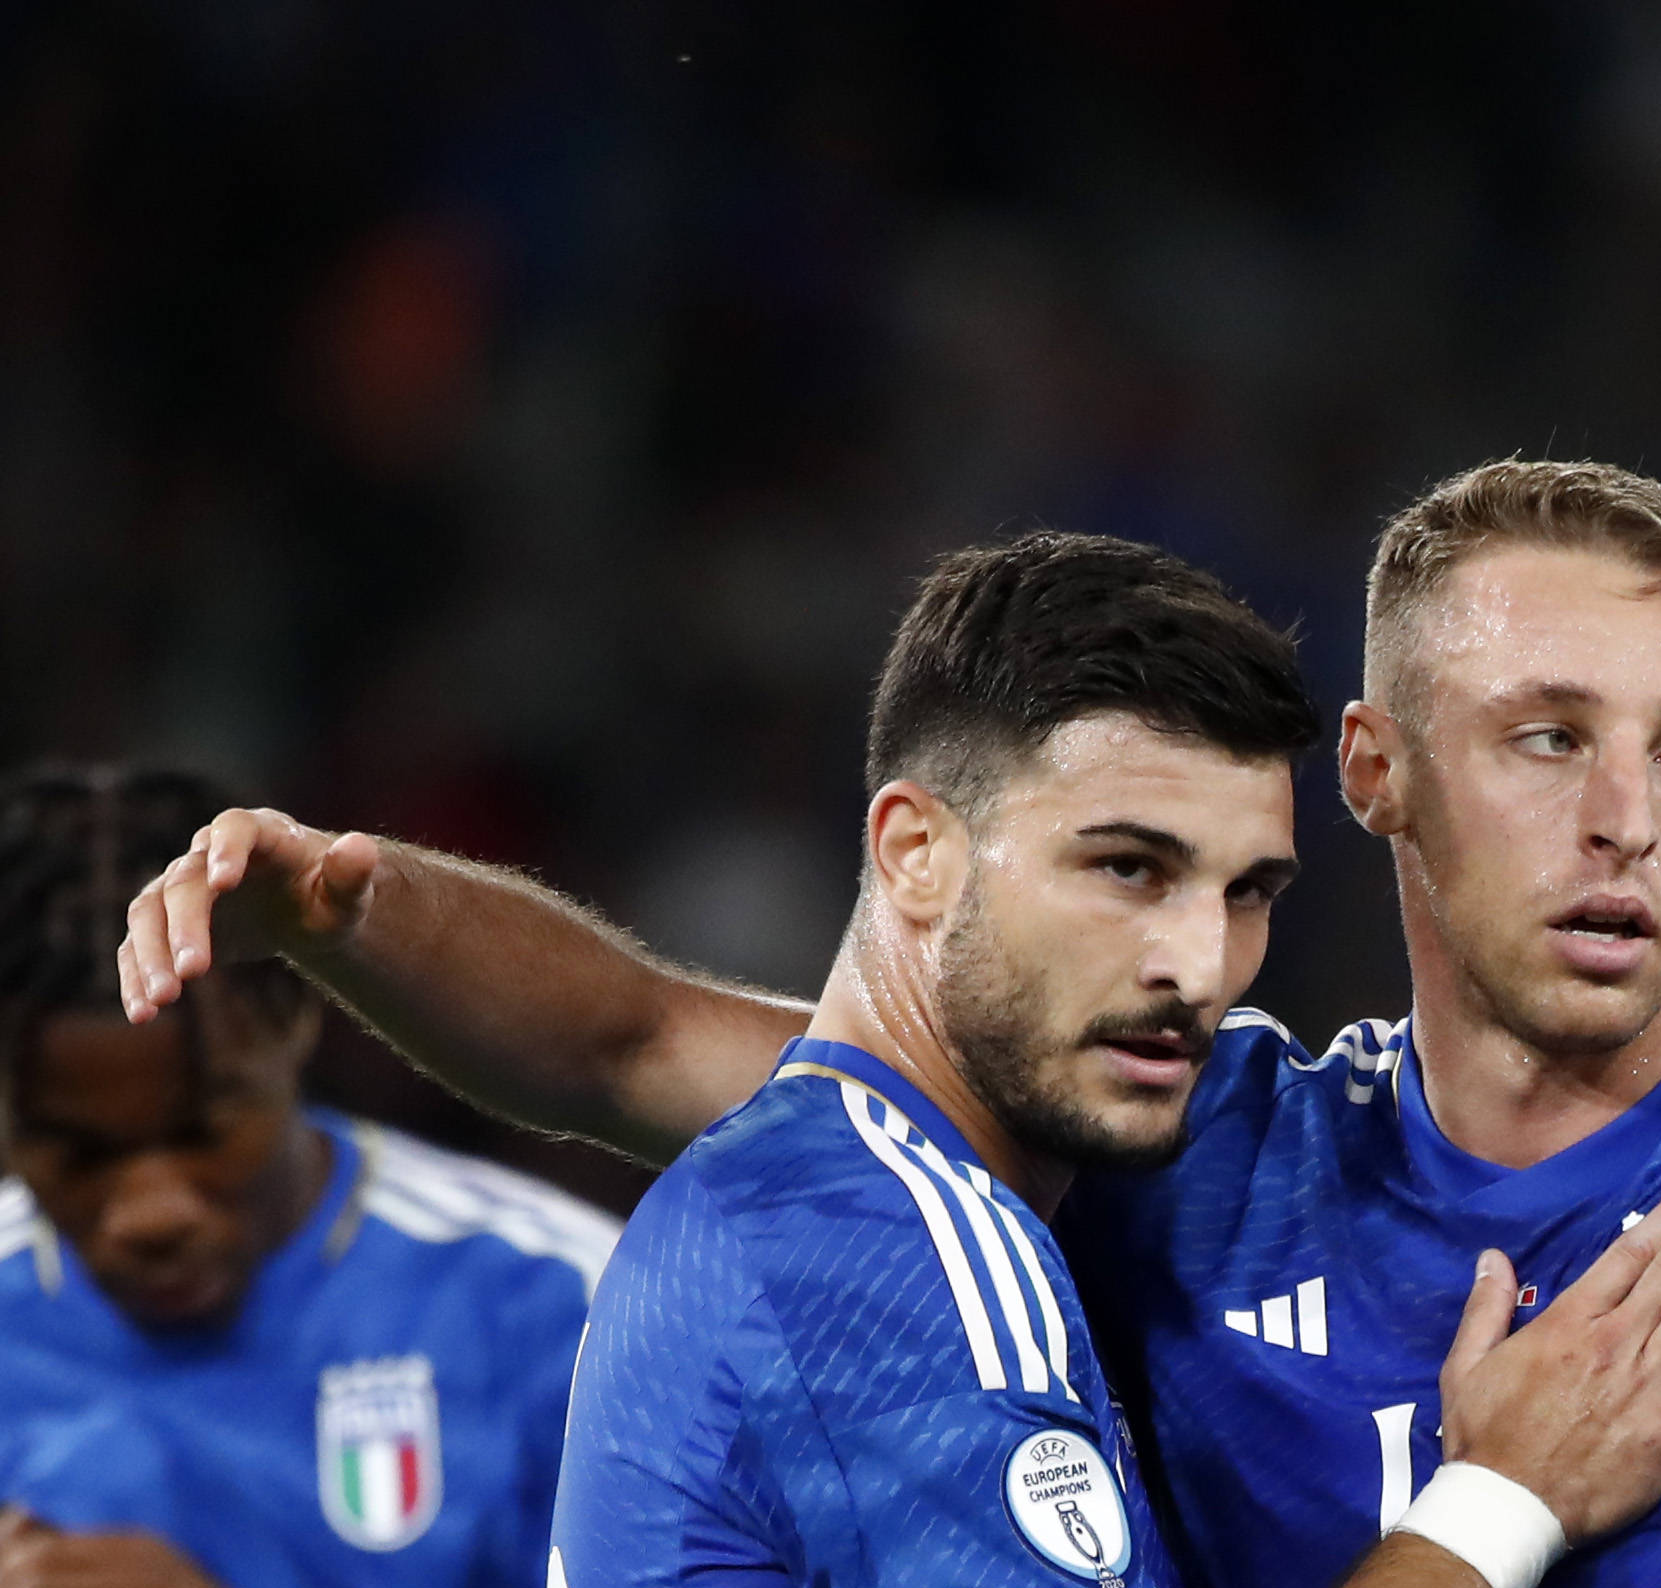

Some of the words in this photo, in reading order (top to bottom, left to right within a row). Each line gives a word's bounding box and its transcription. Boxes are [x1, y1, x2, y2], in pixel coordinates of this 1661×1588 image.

[1032, 1441, 1067, 1462] UEFA
[1023, 1461, 1089, 1487] EUROPEAN
[1029, 1479, 1092, 1502] CHAMPIONS
